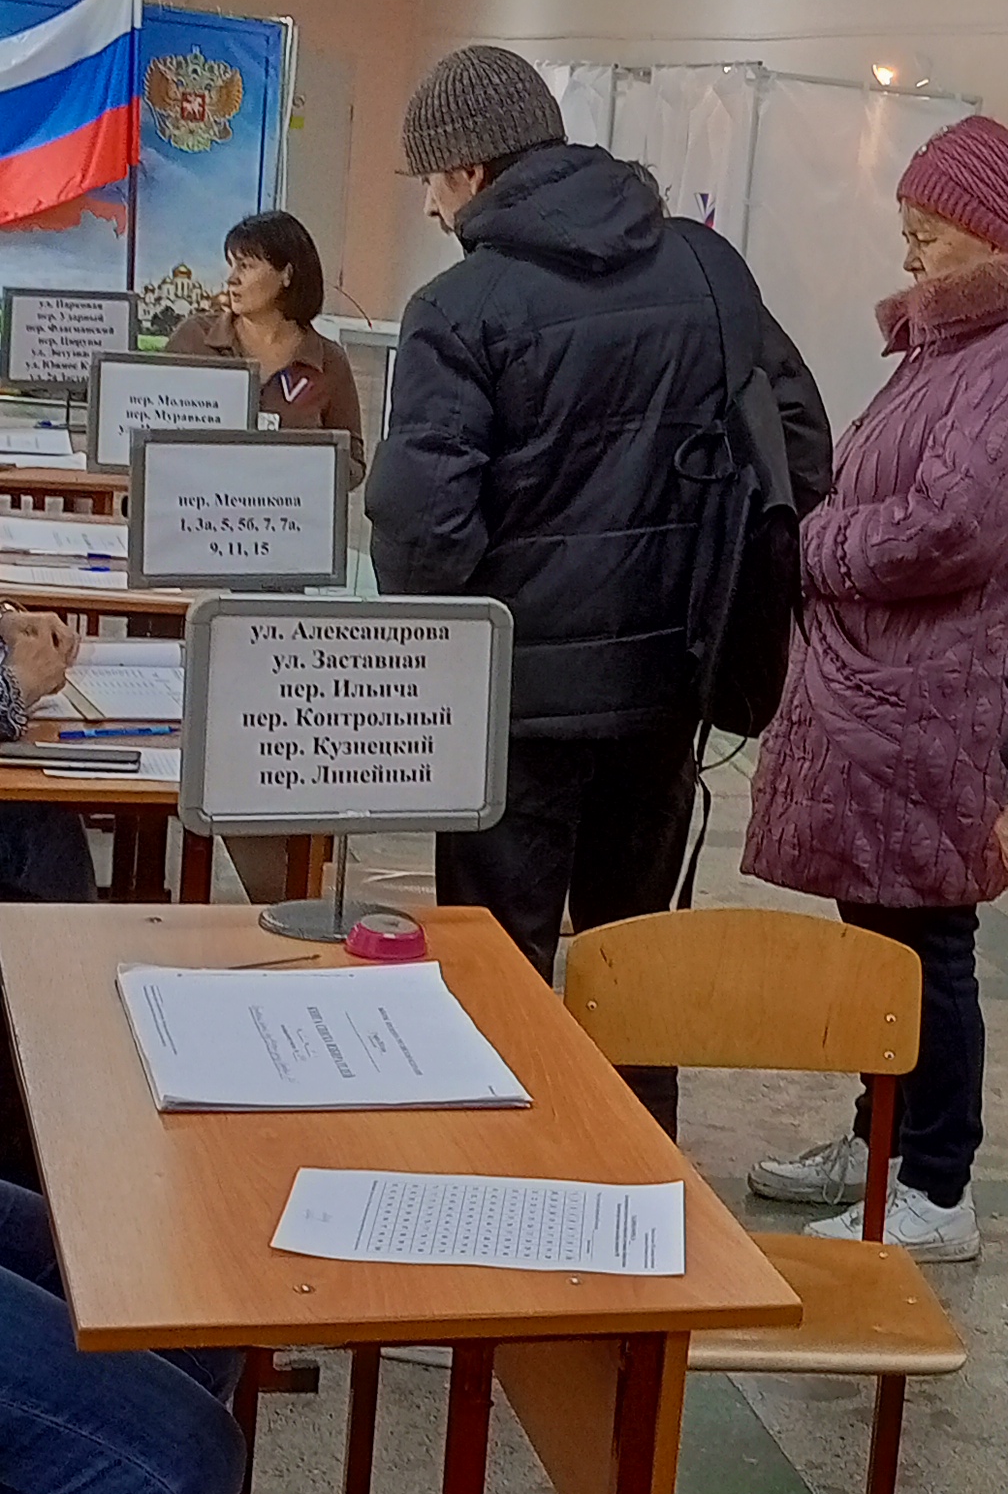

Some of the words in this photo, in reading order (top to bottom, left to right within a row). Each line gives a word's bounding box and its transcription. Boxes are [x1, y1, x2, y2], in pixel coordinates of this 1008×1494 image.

[129, 395, 154, 408] пер.
[157, 394, 219, 409] Молокова
[126, 409, 151, 423] пер.
[154, 409, 222, 424] Муравьева
[178, 495, 210, 510] пер.
[215, 492, 302, 508] Мечникова
[180, 517, 192, 532] 1,
[195, 517, 217, 532] 3а,
[220, 517, 234, 532] 5,
[238, 517, 259, 532] 5б,
[263, 517, 276, 532] 7,
[280, 517, 301, 532] 7а,
[209, 541, 223, 557] 9,
[228, 541, 248, 557] 11,
[254, 541, 270, 556] 15
[250, 624, 284, 645] ул.
[291, 621, 450, 645] Александрова
[271, 654, 305, 675] ул.
[311, 649, 427, 670] Заставная
[279, 682, 325, 703] пер.
[333, 679, 419, 698] Ильича
[242, 712, 288, 732] пер.
[295, 705, 452, 732] Контрольный
[259, 740, 305, 761] пер.
[313, 735, 434, 761] Кузнецкий
[259, 769, 305, 790] пер.
[311, 764, 432, 785] Линейный
